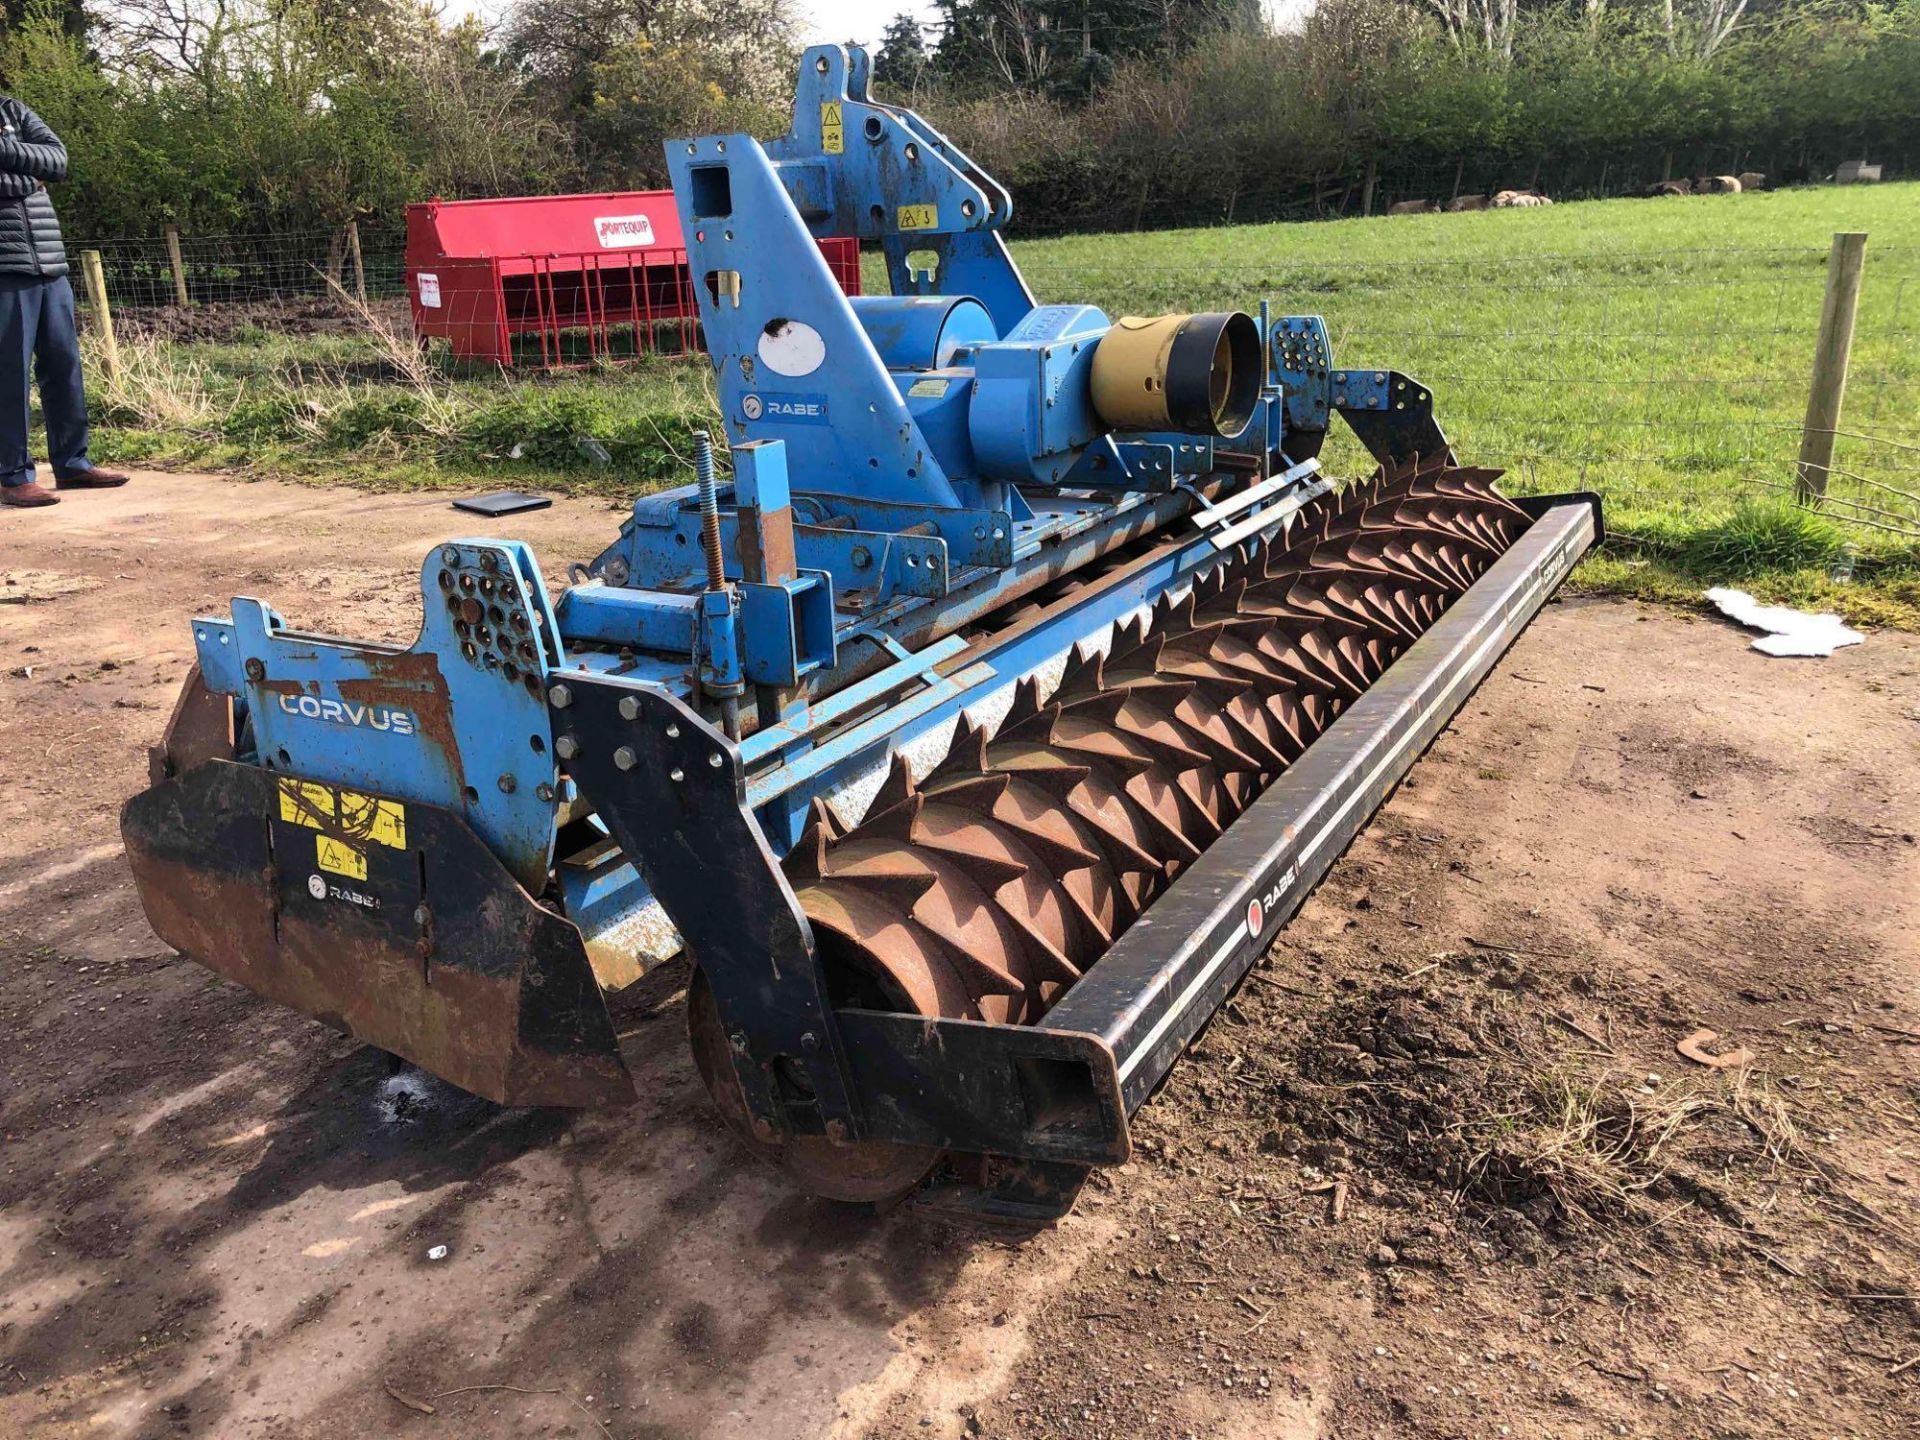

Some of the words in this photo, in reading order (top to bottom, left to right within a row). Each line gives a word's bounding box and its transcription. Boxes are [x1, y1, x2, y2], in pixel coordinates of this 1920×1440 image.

[601, 220, 648, 235] PORTEQUIP
[768, 402, 820, 416] RABE
[279, 694, 416, 735] CORVUS
[329, 885, 375, 908] RABE
[1263, 864, 1296, 914] RABE
